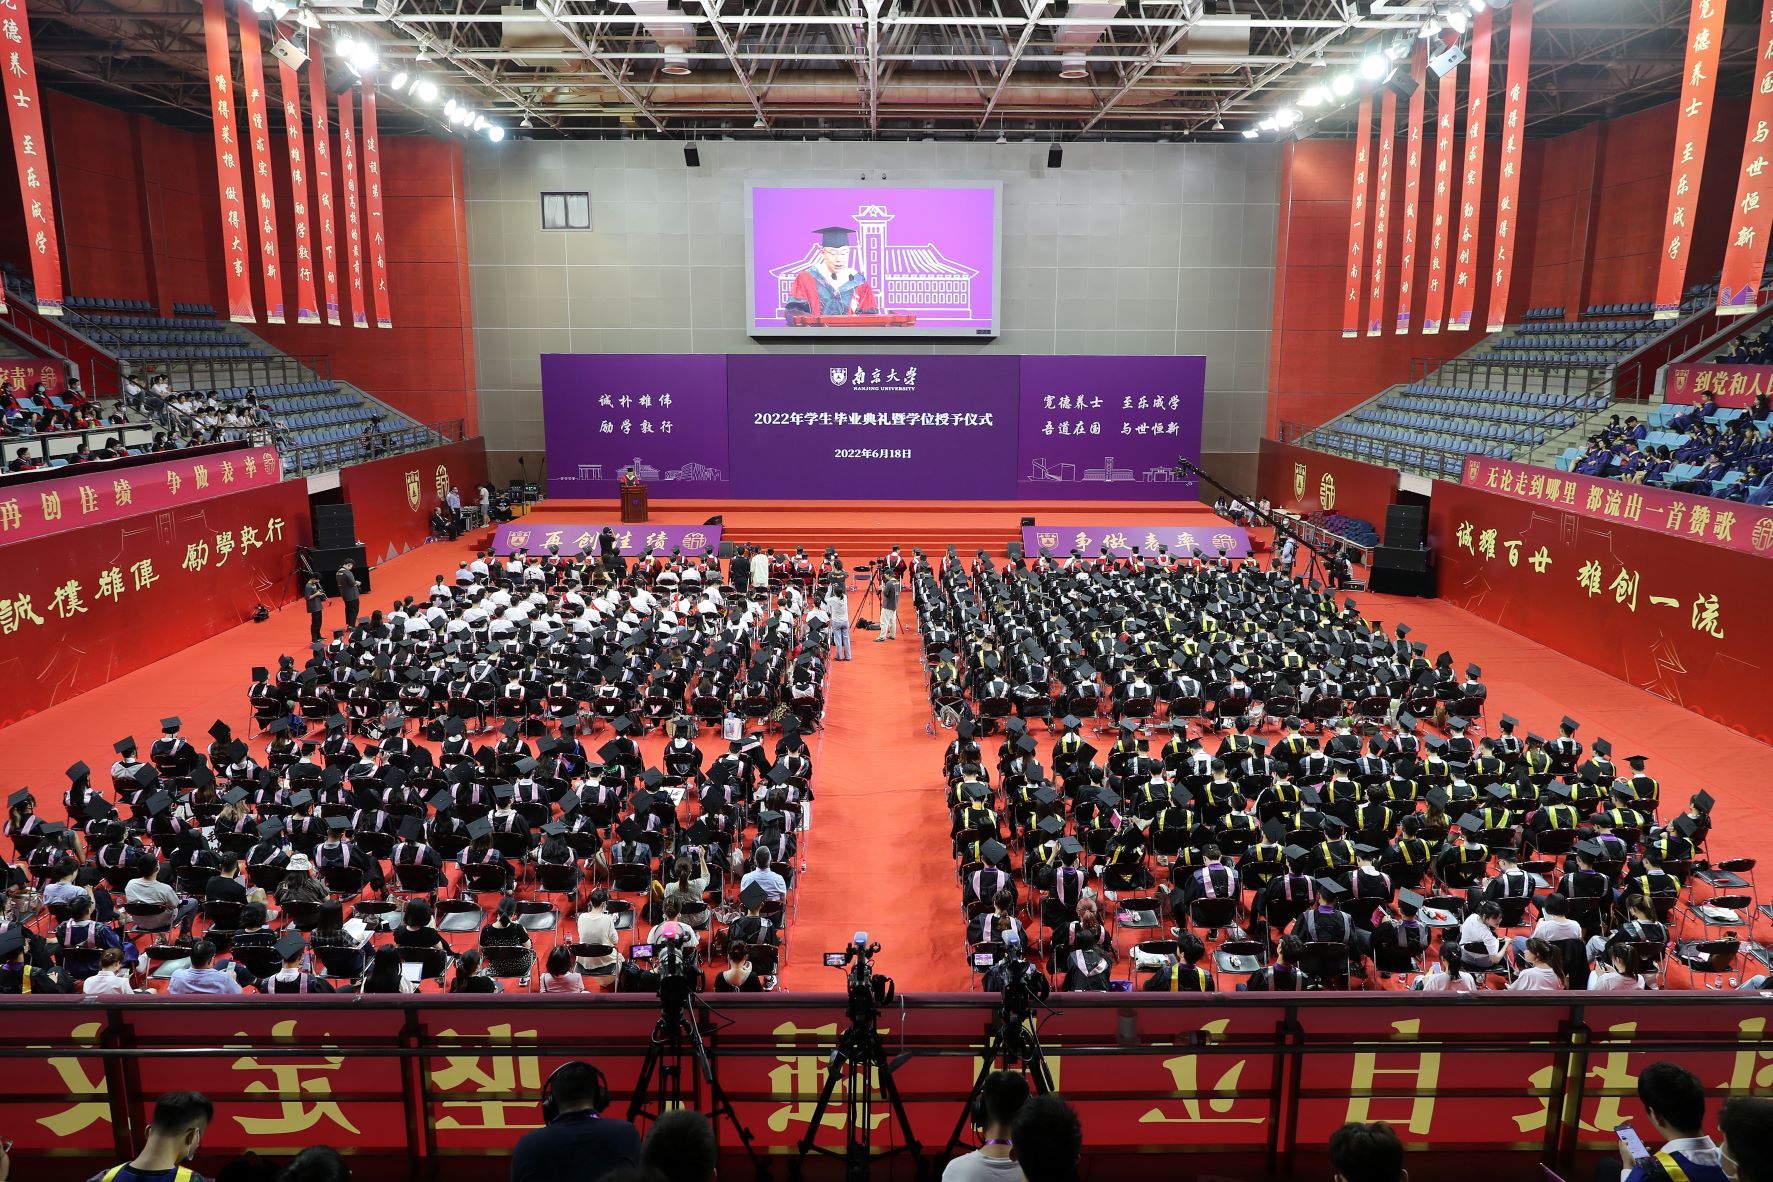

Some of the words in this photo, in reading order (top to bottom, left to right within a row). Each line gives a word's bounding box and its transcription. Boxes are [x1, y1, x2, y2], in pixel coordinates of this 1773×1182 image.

[23, 134, 47, 254] 至乐成学
[1733, 121, 1769, 250] 与世恒新
[1668, 141, 1694, 260] 至乐成学
[851, 365, 918, 386] 南京大学
[598, 392, 673, 409] 诚朴雄伟
[1043, 393, 1104, 411] 宽德养士
[1121, 394, 1181, 411] 至乐成学
[599, 418, 674, 435] 励学敦行
[754, 412, 994, 427] 2022年学生毕业典礼暨学位授予仪式
[1041, 420, 1102, 437] 吾道在国
[1120, 421, 1180, 437] 与世恒新
[834, 448, 912, 459] 2022年6月18日
[0, 479, 133, 532] 再创佳绩
[166, 455, 258, 496] 争做表率
[1485, 466, 1577, 506] 无论走到哪里
[1586, 484, 1737, 542] 都流出一首赞歌
[1075, 531, 1200, 551] 争做表率
[1456, 520, 1553, 574] 诚耀百廿
[1576, 560, 1724, 639] 雄创一流
